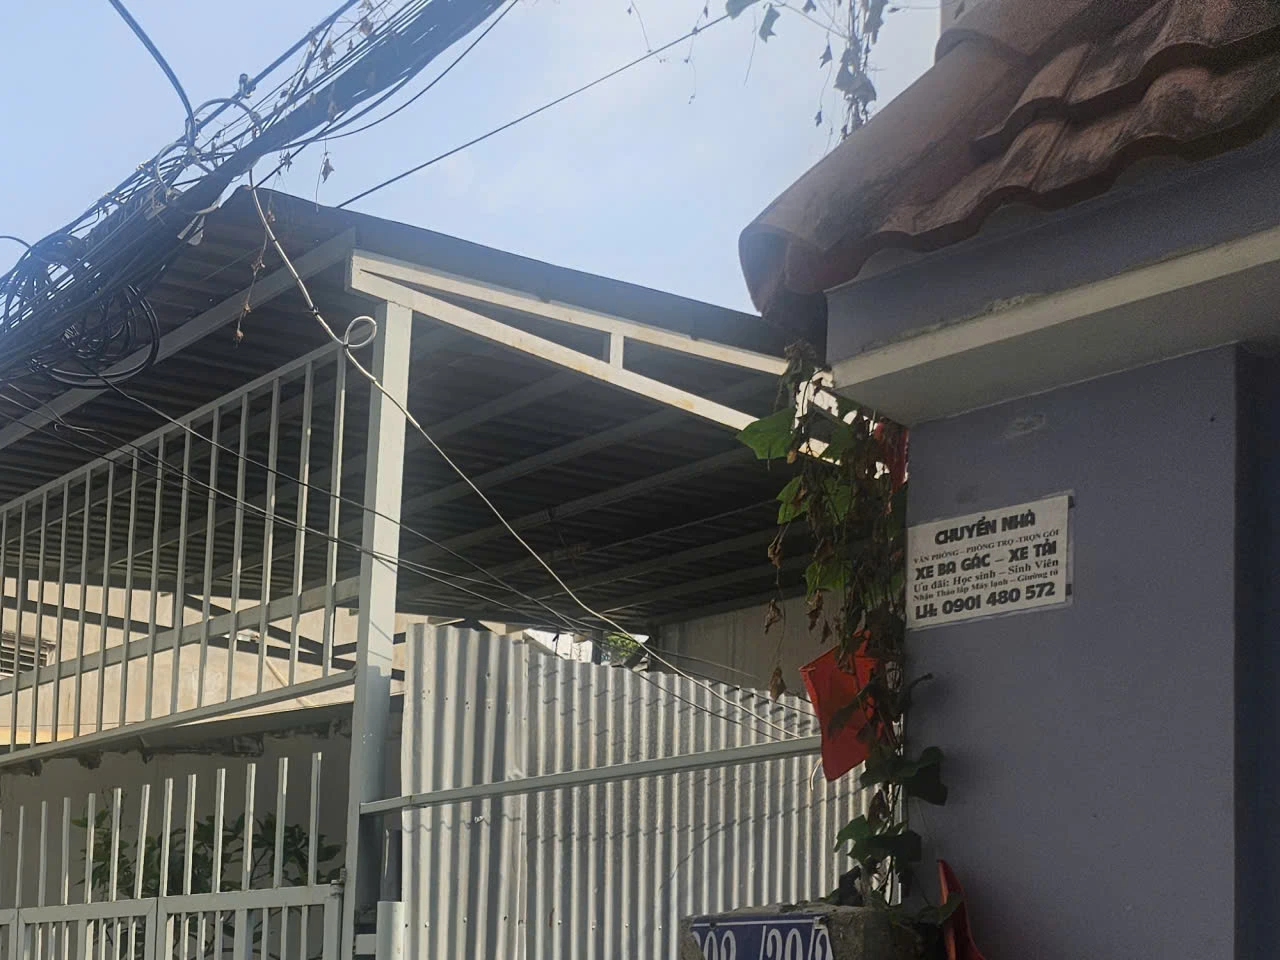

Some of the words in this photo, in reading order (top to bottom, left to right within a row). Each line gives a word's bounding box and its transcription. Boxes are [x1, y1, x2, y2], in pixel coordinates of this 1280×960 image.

[935, 516, 997, 544] CHUYỂN
[1002, 509, 1035, 532] NHÀ
[915, 565, 933, 580] XE
[938, 562, 956, 576] BA
[961, 553, 990, 572] GÁC
[1008, 546, 1028, 562] XE
[1033, 539, 1056, 557] TẢI
[966, 541, 994, 553] PHÒNG
[953, 575, 972, 586] Học
[975, 570, 996, 581] sinh
[1008, 564, 1031, 575] Sinh
[1035, 559, 1059, 569] Viên
[942, 595, 981, 615] 0901
[986, 588, 1020, 607] 480
[1025, 582, 1055, 600] 572
